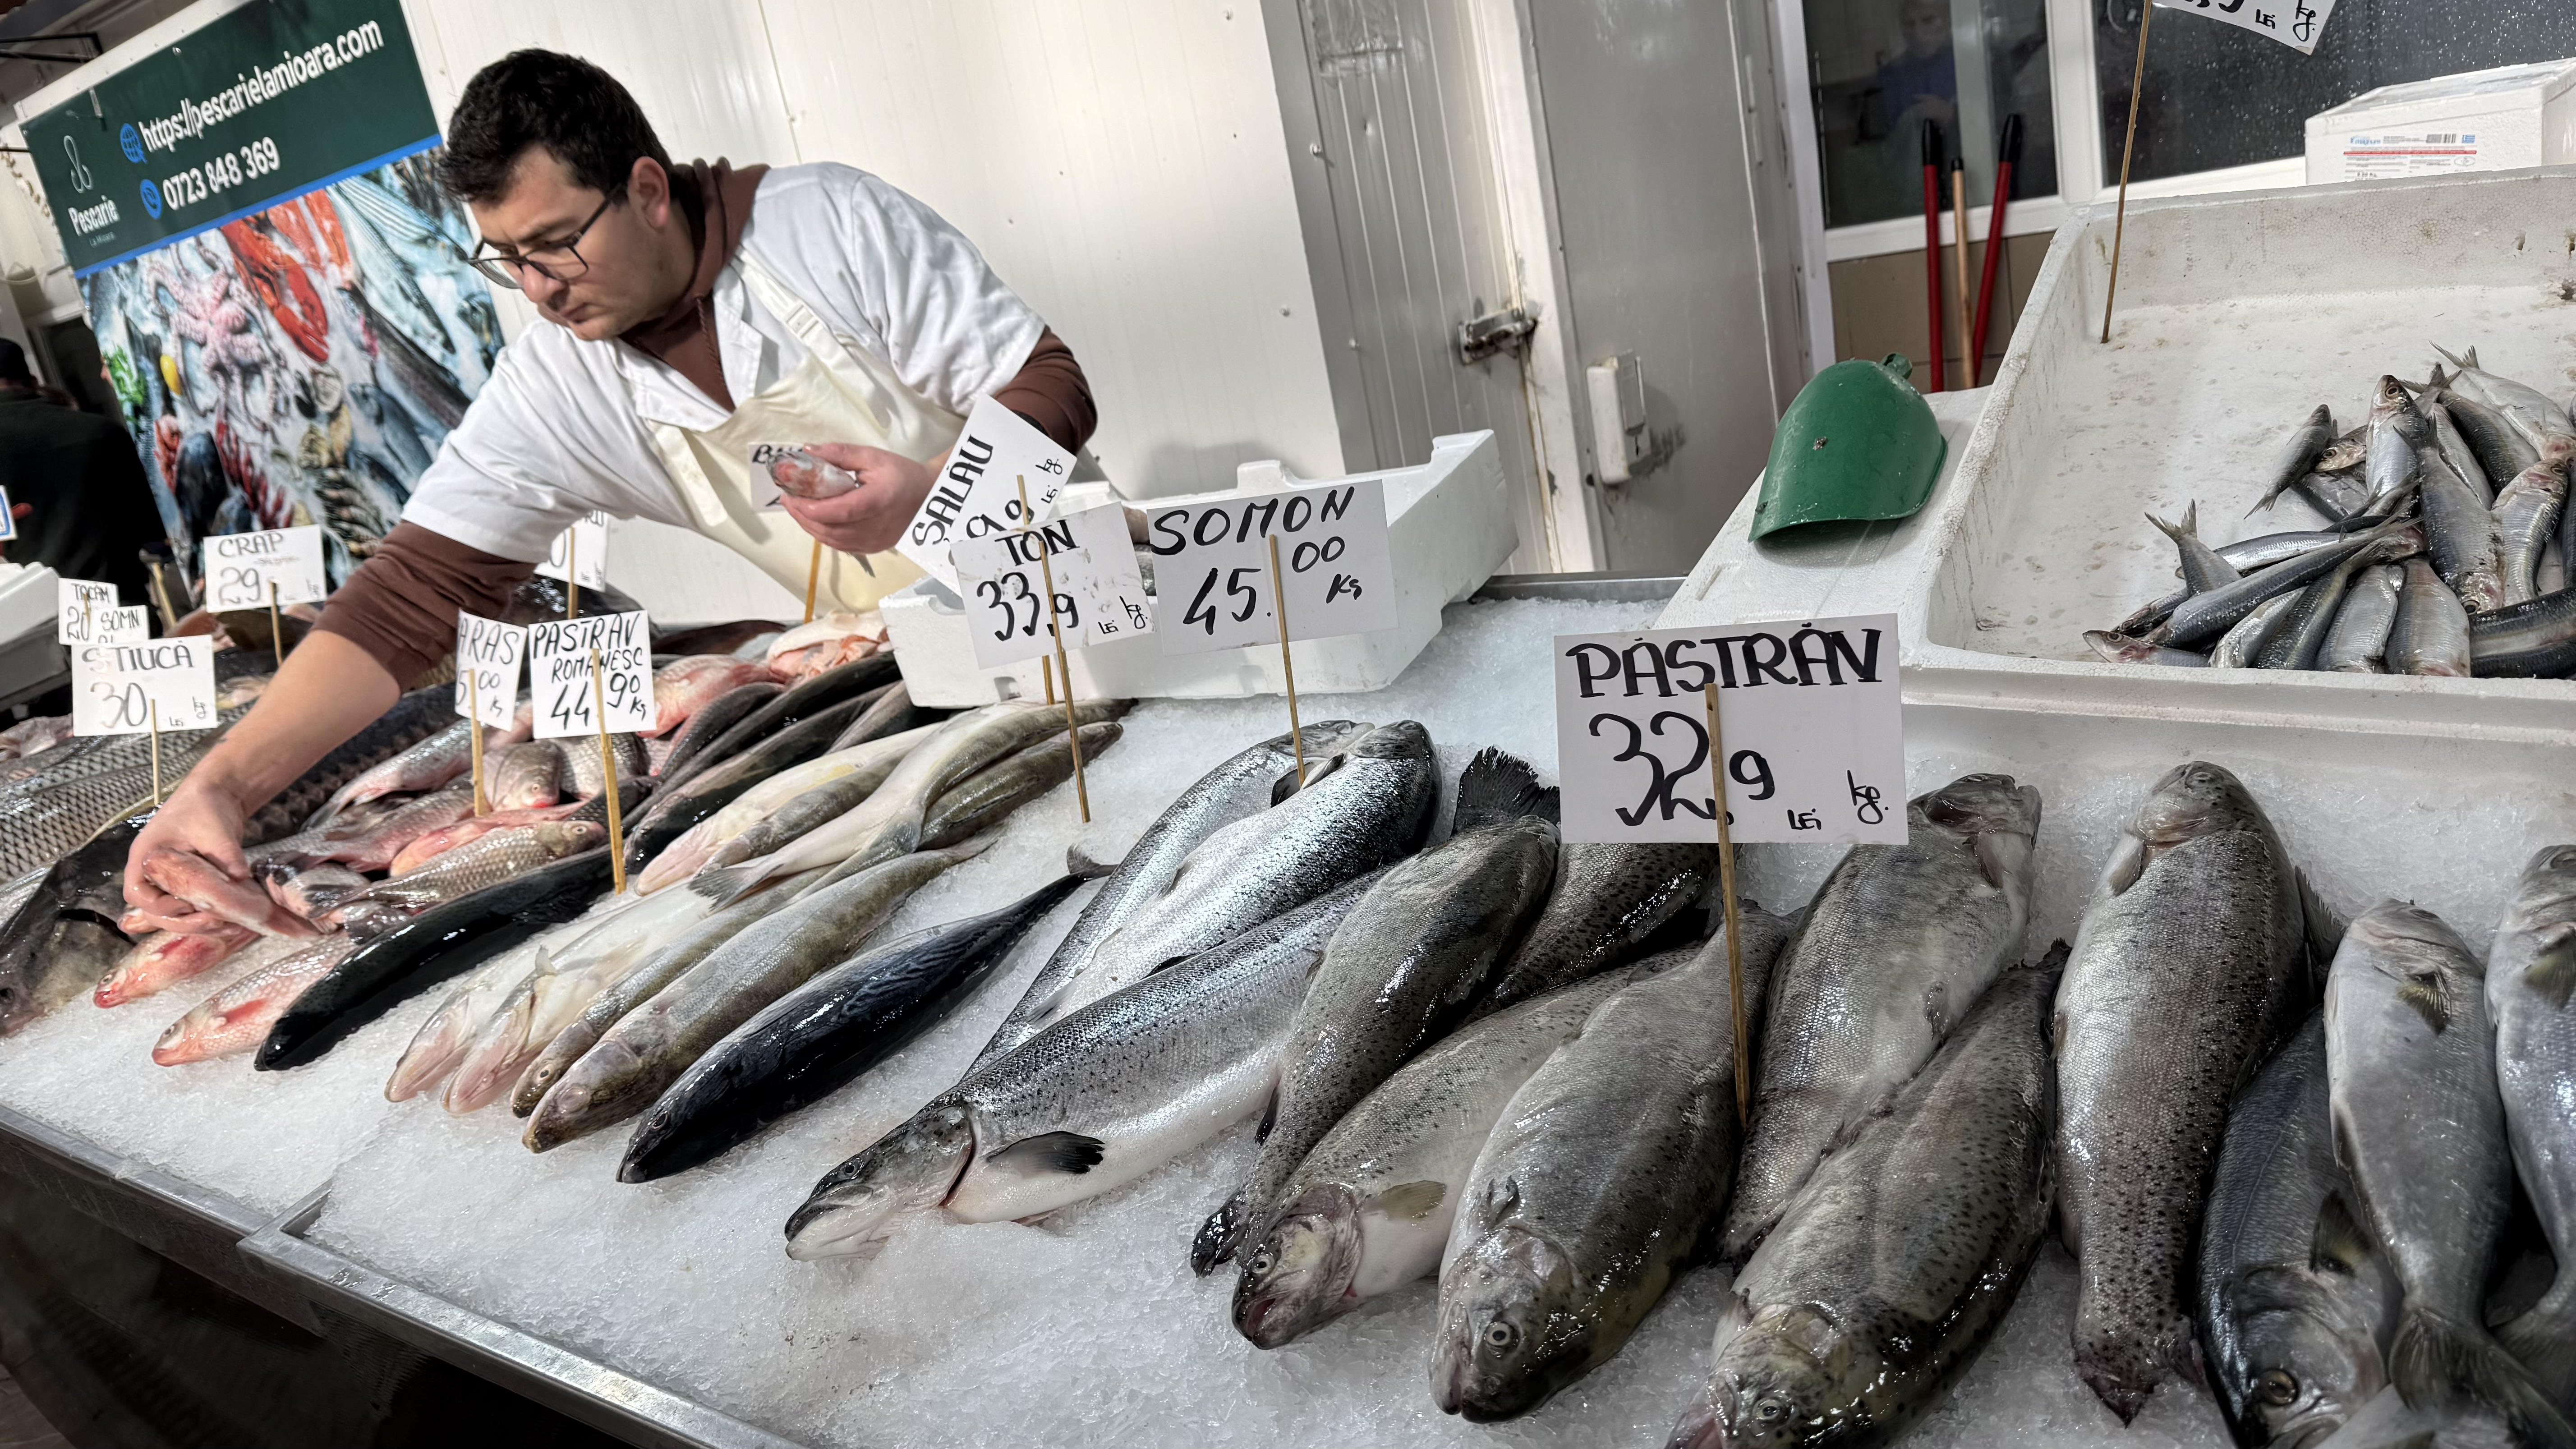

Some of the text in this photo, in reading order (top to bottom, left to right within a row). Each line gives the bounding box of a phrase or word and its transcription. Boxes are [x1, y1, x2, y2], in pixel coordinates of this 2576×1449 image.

[138, 20, 384, 153] https://pescarielamioara.com
[162, 136, 281, 210] 0723 848 369
[68, 195, 120, 236] Pescarie
[218, 531, 284, 557] CRAP
[994, 519, 1081, 567] TON
[1151, 486, 1355, 556] SOMON
[218, 566, 261, 605] 29
[100, 609, 139, 631] SOMN
[459, 617, 519, 664] ARAS
[534, 613, 640, 659] PASTRAV
[552, 647, 643, 684] ROMANESC
[90, 682, 147, 729] 30
[550, 681, 590, 731] 44
